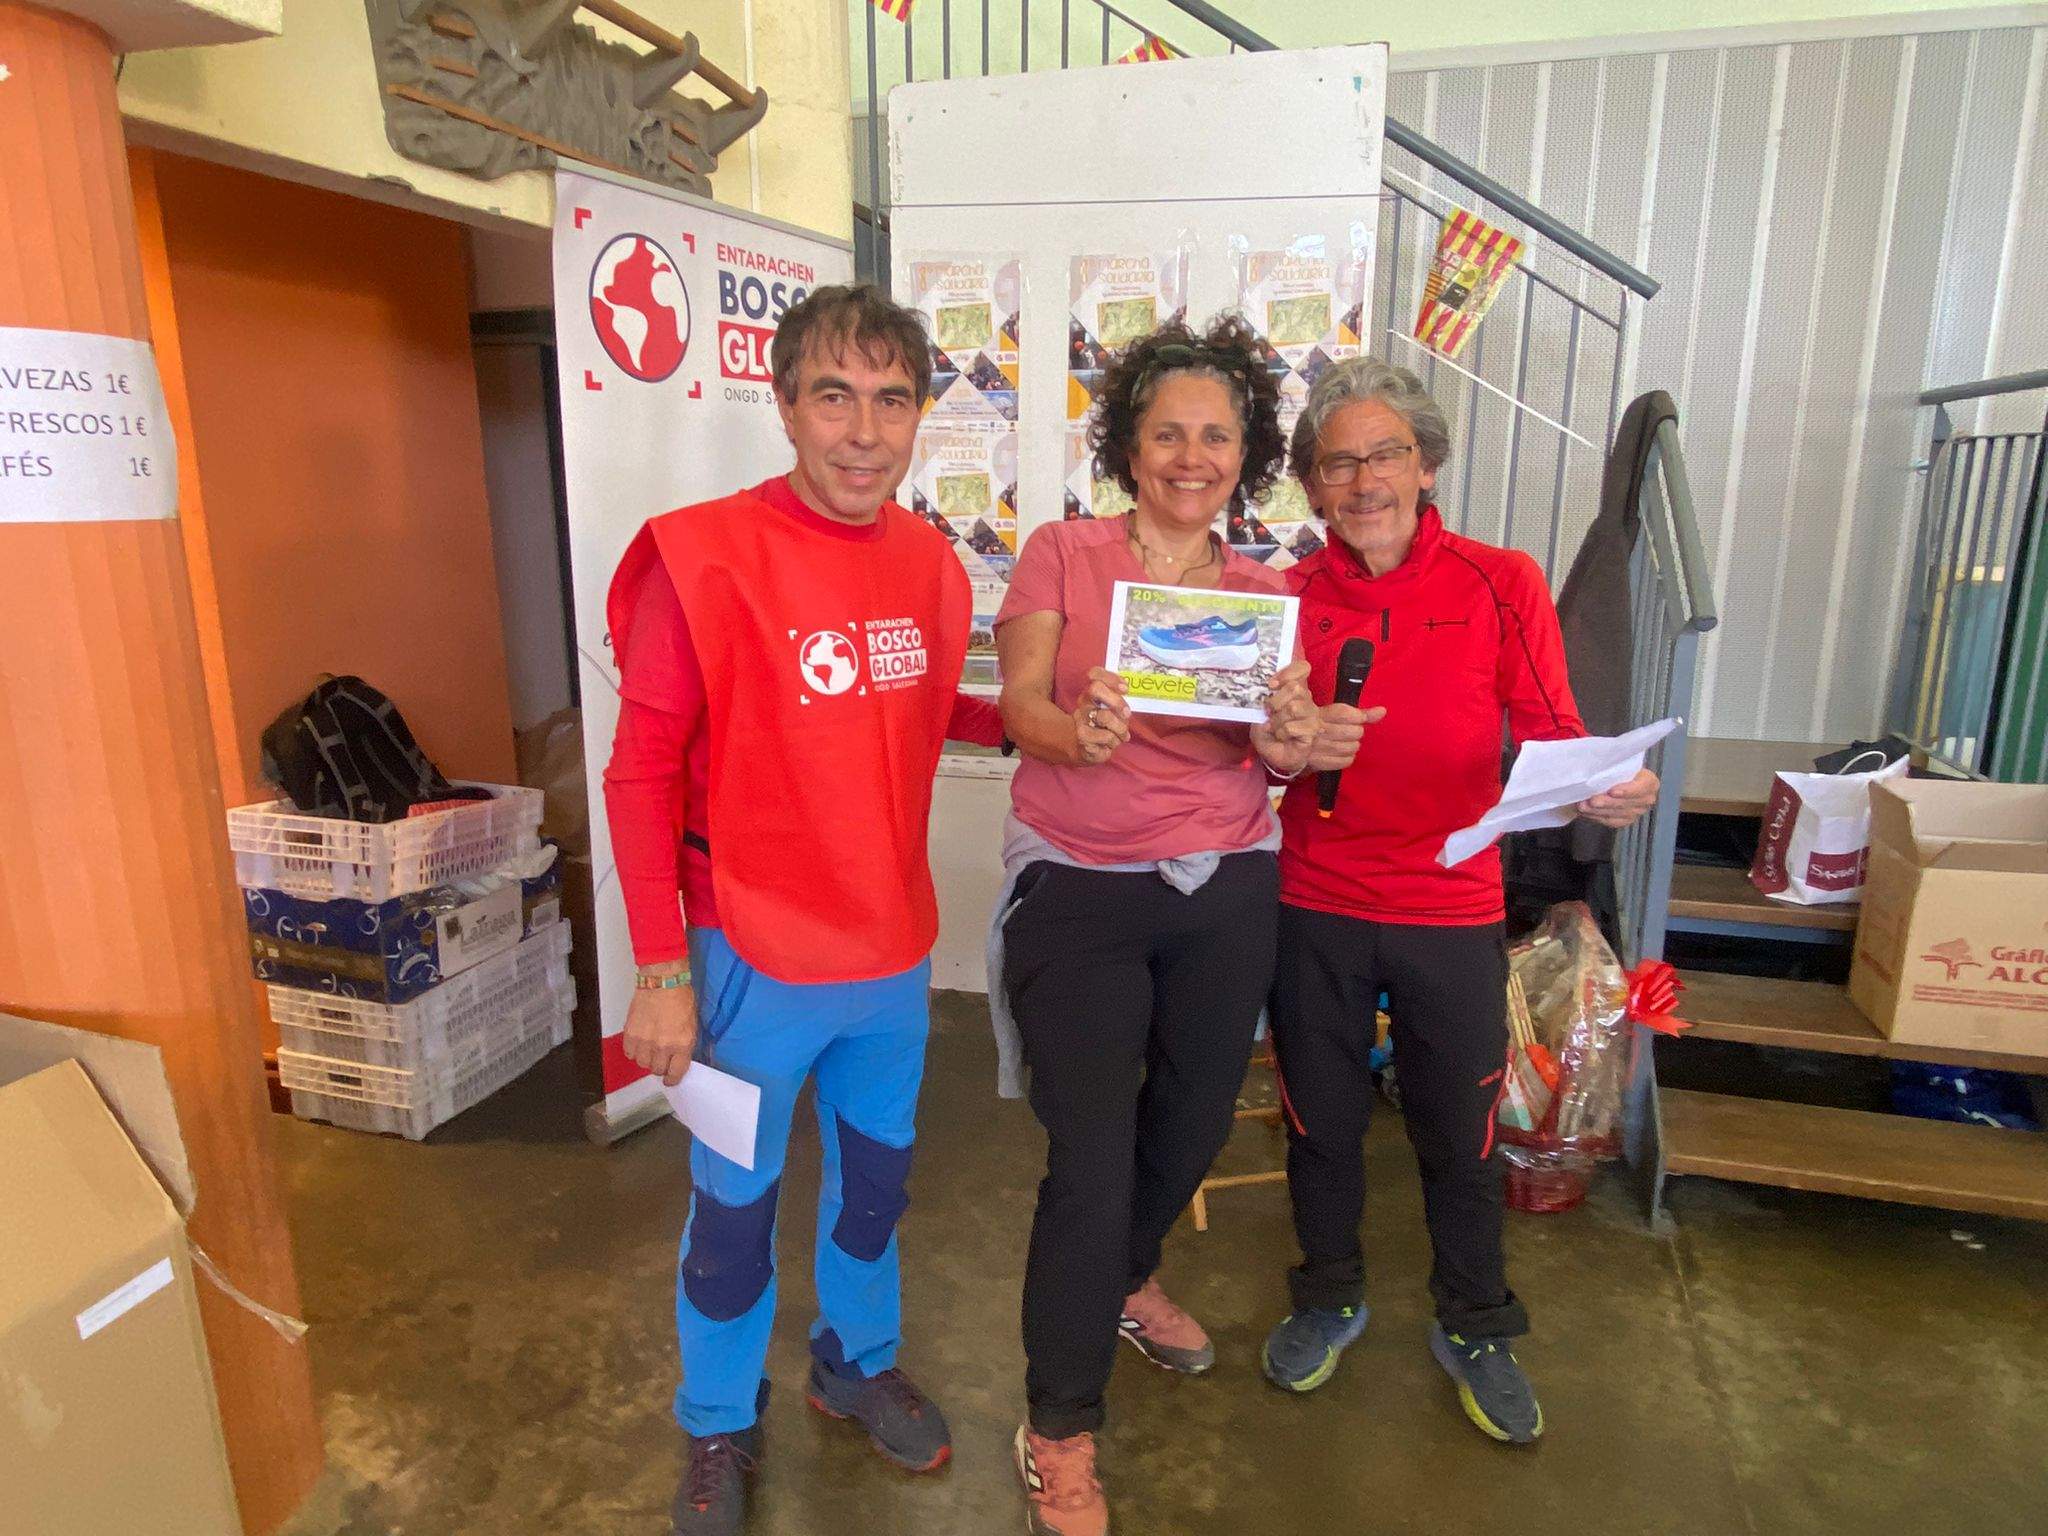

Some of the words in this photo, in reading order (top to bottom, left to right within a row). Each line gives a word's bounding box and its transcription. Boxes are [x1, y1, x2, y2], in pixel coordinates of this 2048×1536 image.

[717, 243, 814, 283] ENTARACHEN
[0, 367, 93, 392] VEZAS
[106, 373, 131, 395] 1€
[724, 387, 759, 404] ONGD
[0, 450, 53, 477] FÉS
[129, 456, 152, 477] 1€
[1132, 589, 1167, 604] 20%
[867, 627, 922, 654] BOSCO
[872, 653, 925, 679] GLOBAL
